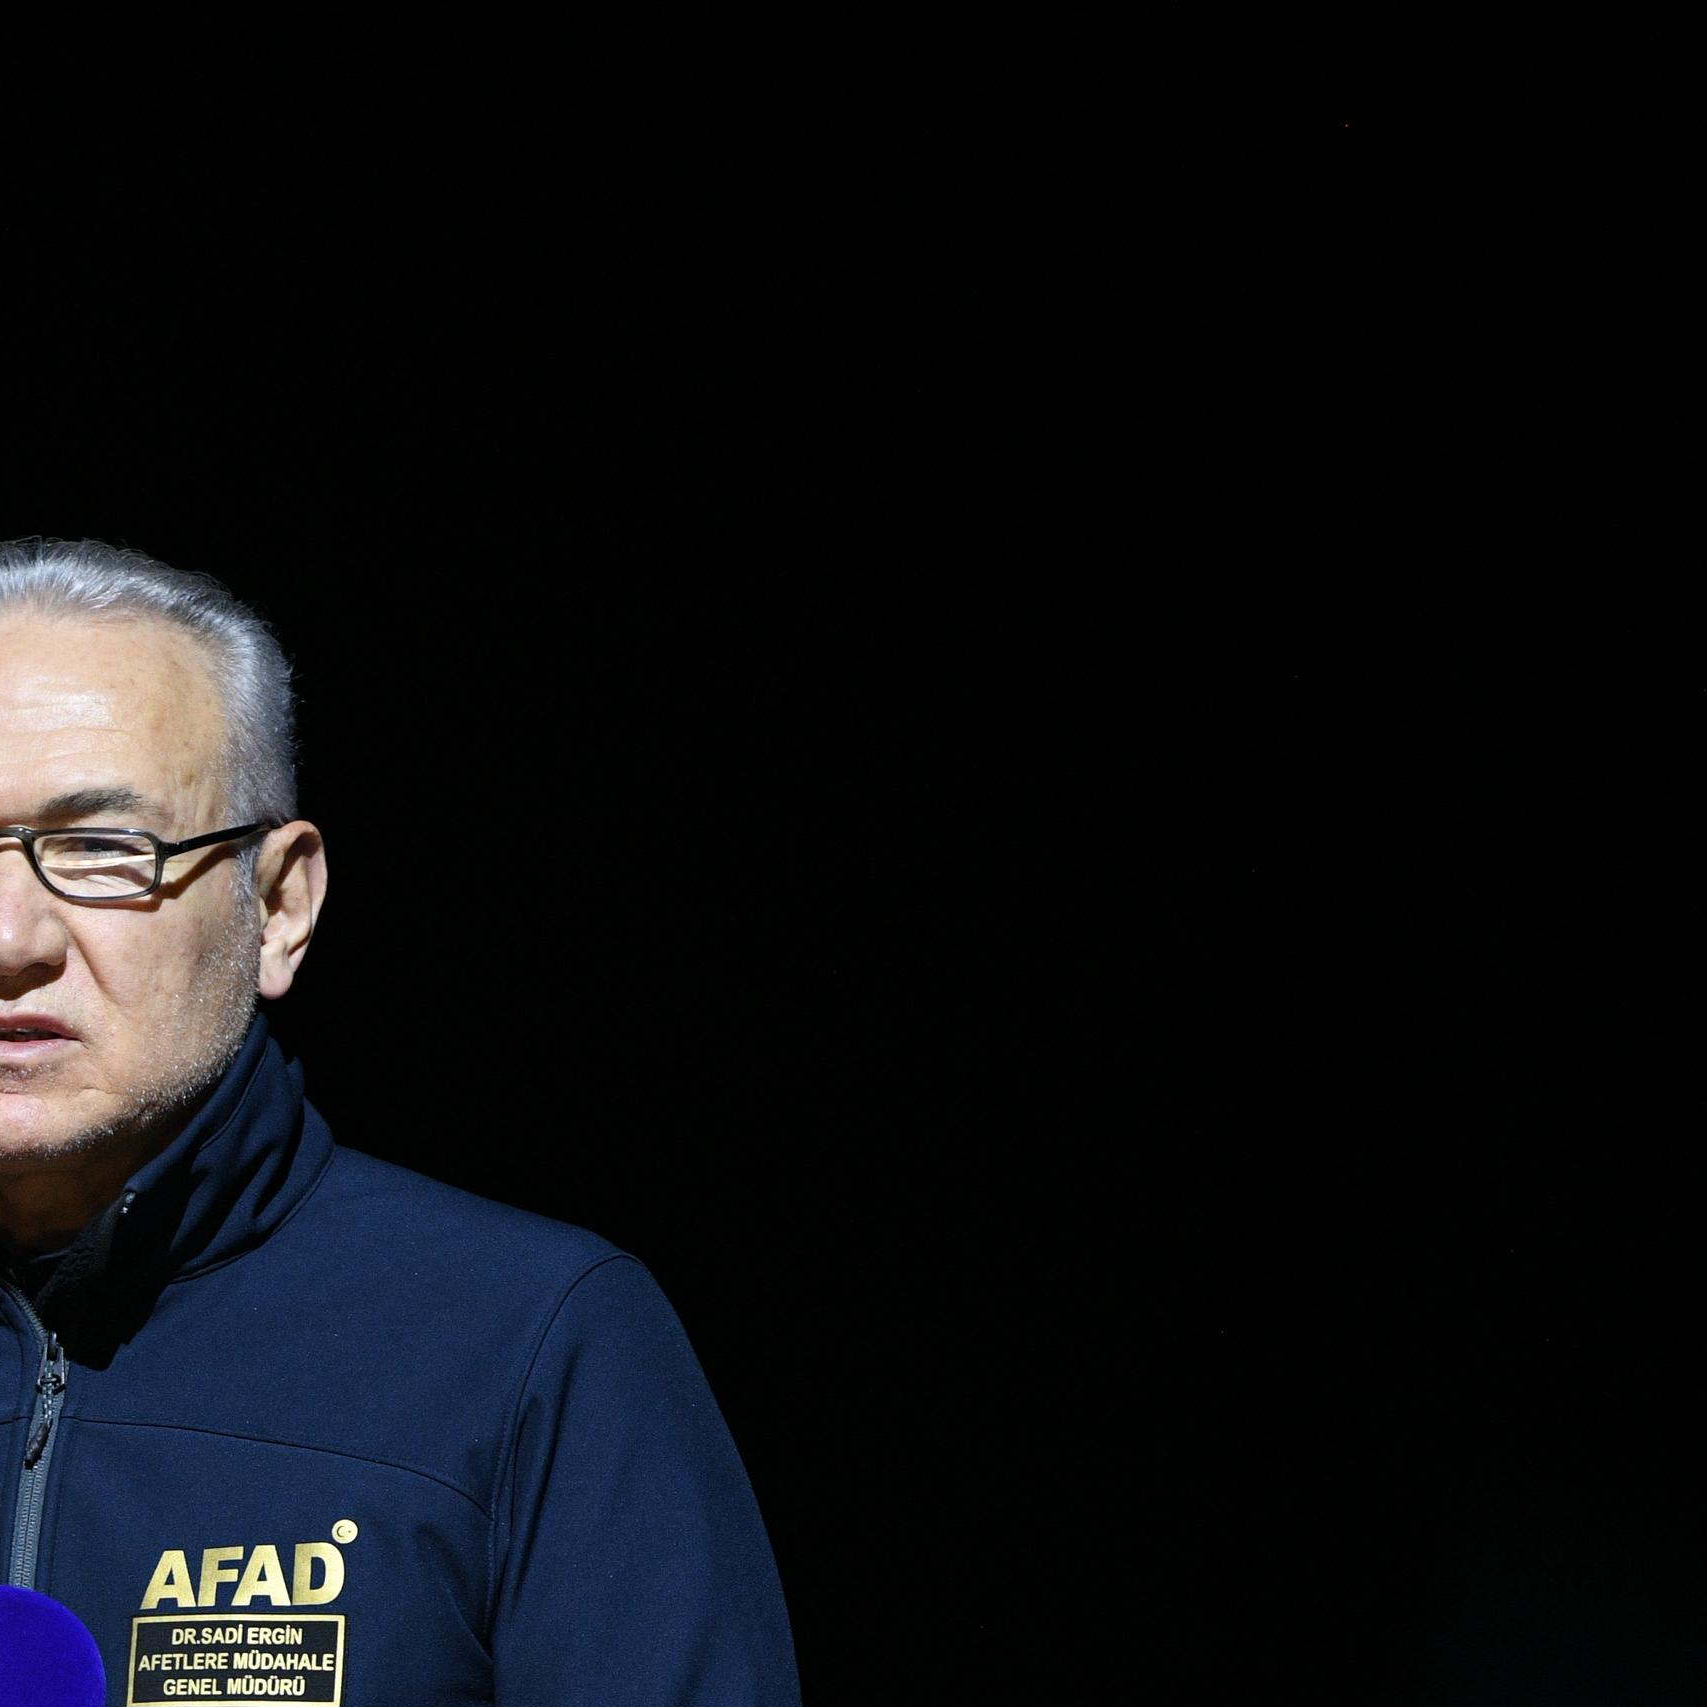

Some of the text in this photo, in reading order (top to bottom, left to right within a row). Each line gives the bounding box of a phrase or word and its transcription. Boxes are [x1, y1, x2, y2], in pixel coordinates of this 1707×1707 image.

[140, 1541, 345, 1610] AFAD
[247, 1624, 303, 1645] ERGİN
[138, 1650, 335, 1672] AFETLERE MÜDAHALE
[163, 1675, 306, 1697] GENEL MÜDÜRÜ
